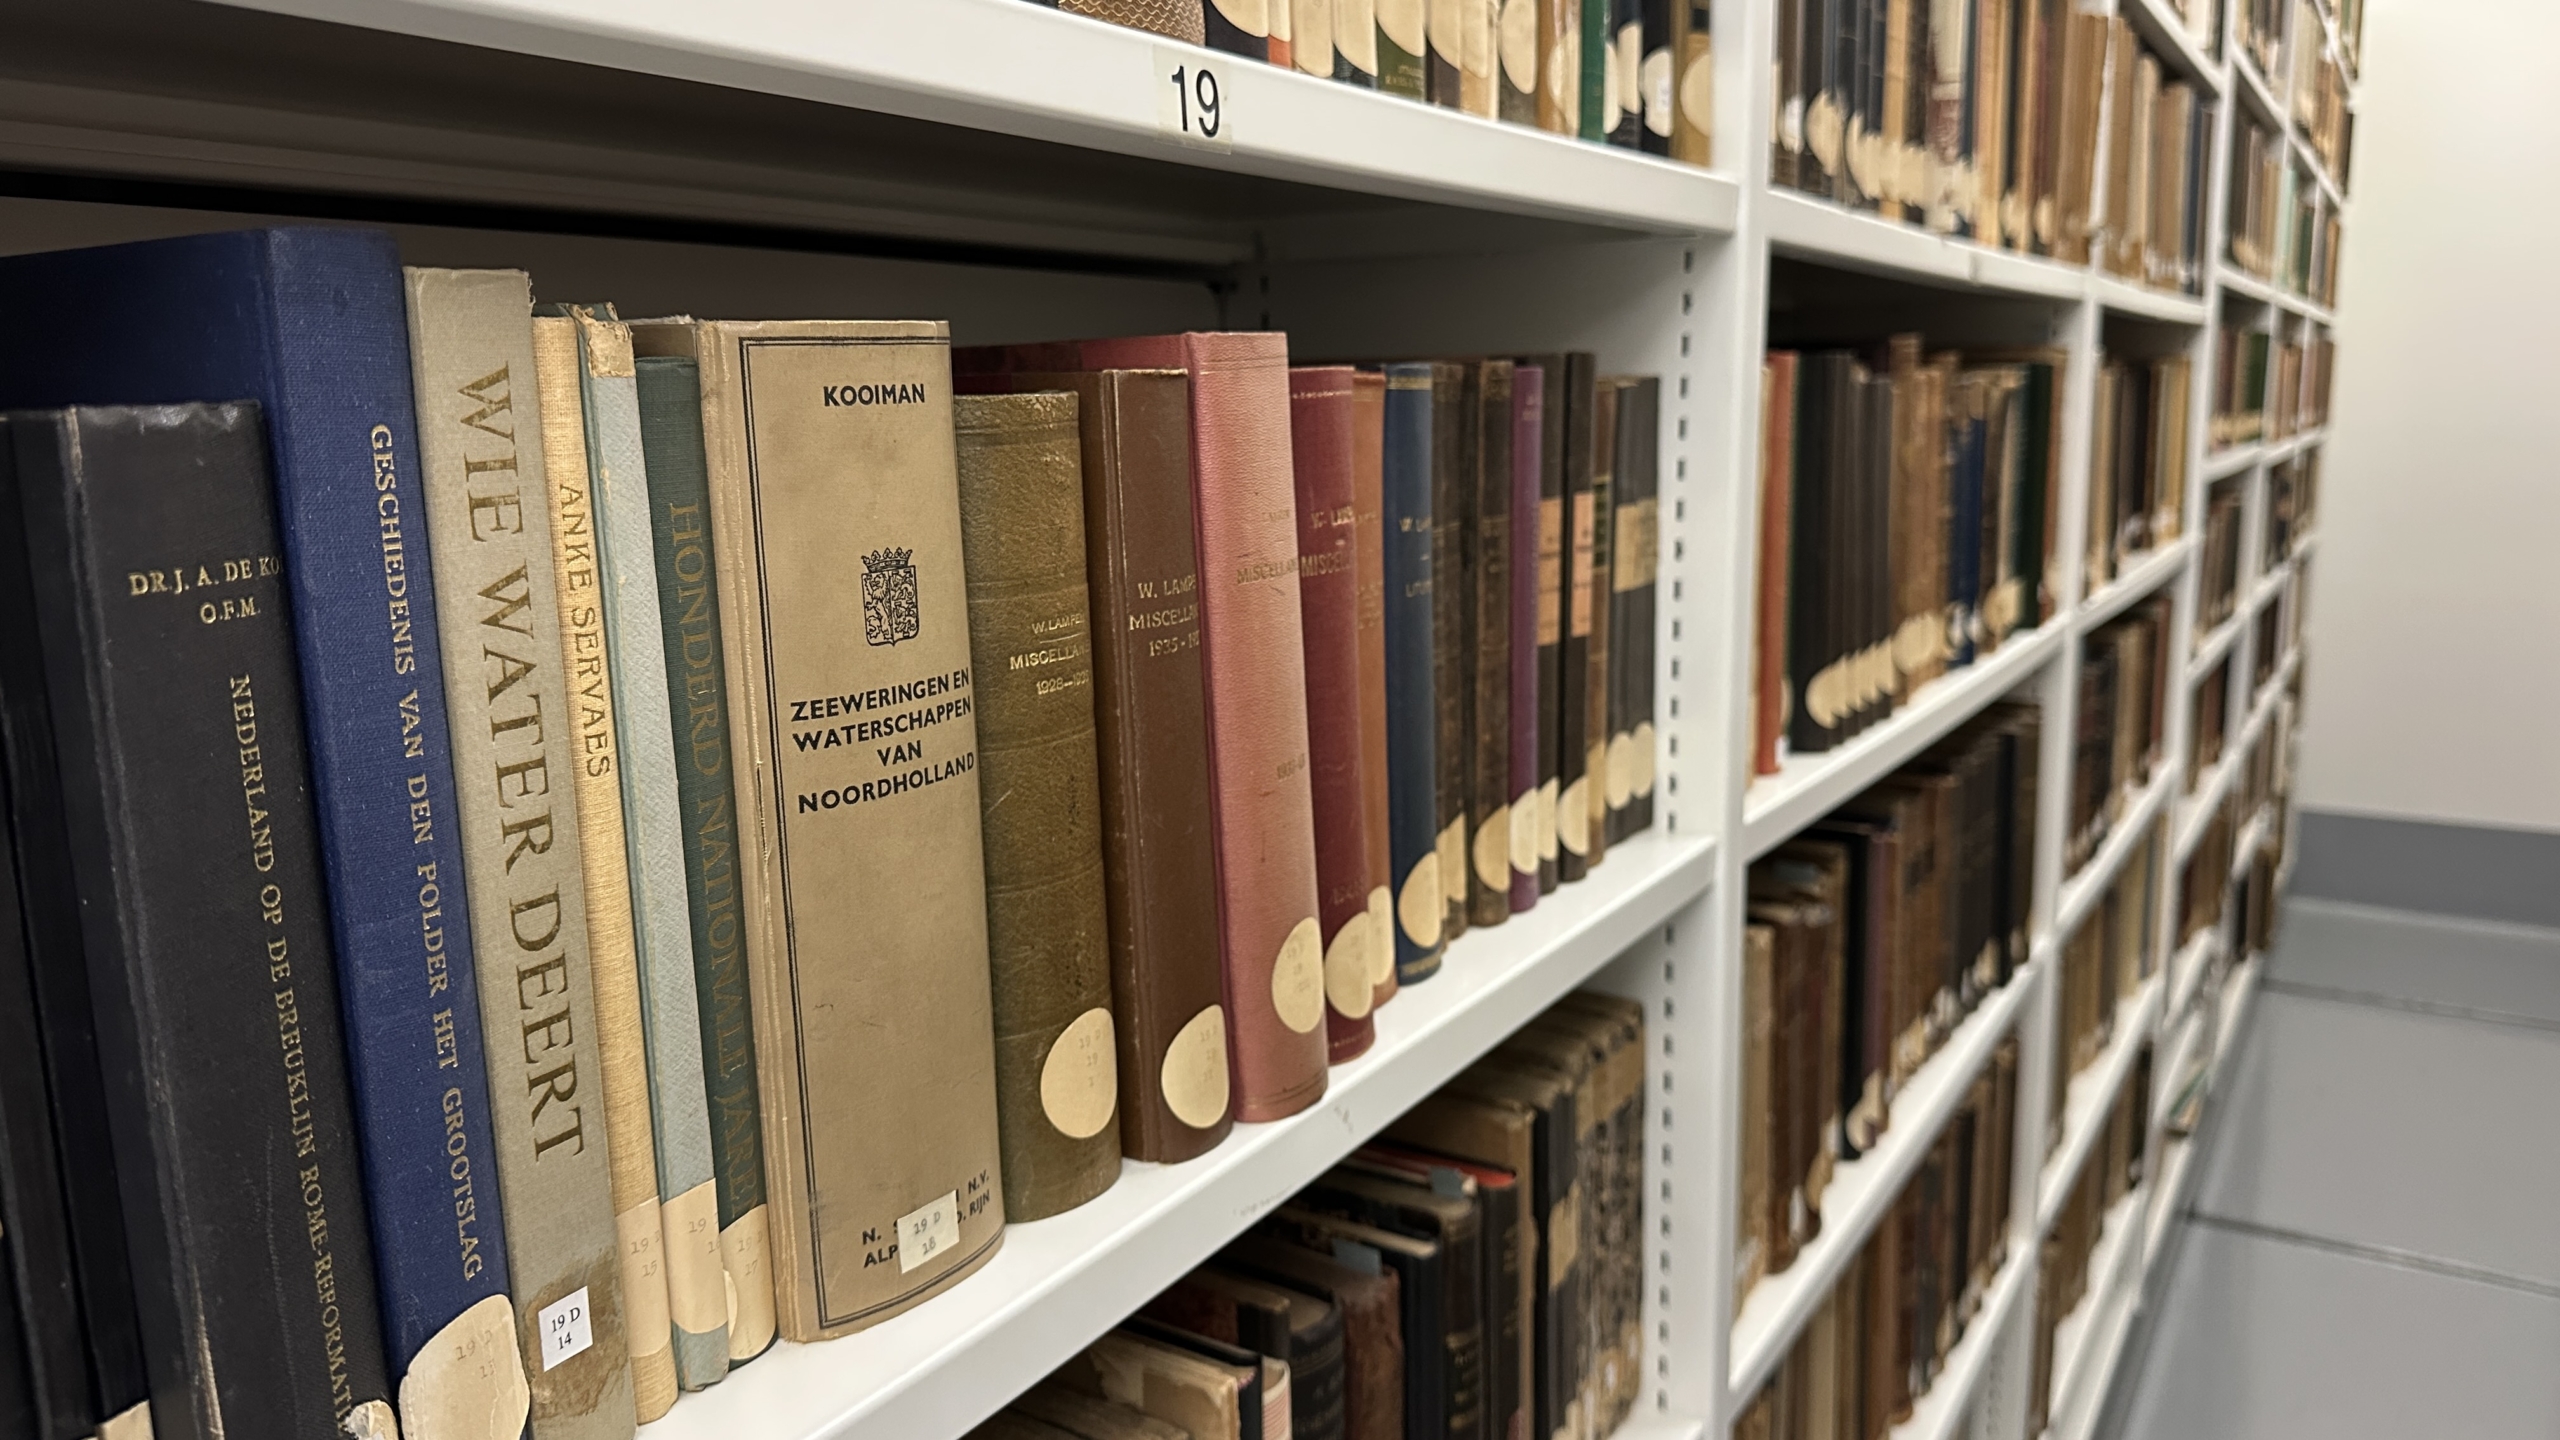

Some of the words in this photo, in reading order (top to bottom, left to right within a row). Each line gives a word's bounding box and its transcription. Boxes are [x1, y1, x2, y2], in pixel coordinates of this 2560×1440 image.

[1171, 64, 1220, 138] 19
[823, 383, 925, 407] KOOIMAN
[457, 362, 524, 543] WIE
[371, 424, 416, 675] GESCHIEDENIS
[559, 484, 594, 591] ANKE
[197, 565, 220, 587] A.
[224, 559, 253, 582] DE
[1138, 581, 1158, 599] W.
[201, 596, 262, 625] O.F.M.
[571, 606, 611, 778] SERVAES
[790, 674, 949, 722] ZEEWERINGEN
[953, 667, 970, 690] EN
[400, 689, 424, 758] VAN
[477, 559, 555, 877] WATER
[792, 695, 972, 753] WATERSCHAPPEN
[230, 674, 275, 873] NEDERLAND
[877, 740, 923, 767] VAN
[669, 501, 723, 777] HONDERD
[696, 790, 748, 1079] NATIONALE
[798, 751, 975, 814] NOORDHOLLAND
[407, 774, 434, 844] DEN
[261, 884, 283, 925] OP
[417, 860, 448, 999] POLDER
[267, 936, 292, 983] DE
[433, 1008, 459, 1069] HET
[508, 882, 586, 1163] DEERT
[274, 986, 316, 1158] BREUKLIJN
[442, 1087, 483, 1281] GROOTSLAG
[967, 1169, 990, 1195] N.V.
[969, 1189, 990, 1216] RIJN
[688, 1217, 707, 1234] 19
[737, 1235, 752, 1253] 19
[862, 1227, 881, 1245] N.
[913, 1217, 928, 1235] 19
[933, 1210, 941, 1224] D
[630, 1237, 649, 1255] 19
[744, 1258, 759, 1276] 17
[922, 1235, 937, 1256] 18
[641, 1259, 658, 1278] 15
[551, 1314, 566, 1334] 19
[570, 1306, 581, 1323] D
[557, 1331, 573, 1350] 14
[455, 1340, 477, 1361] 19
